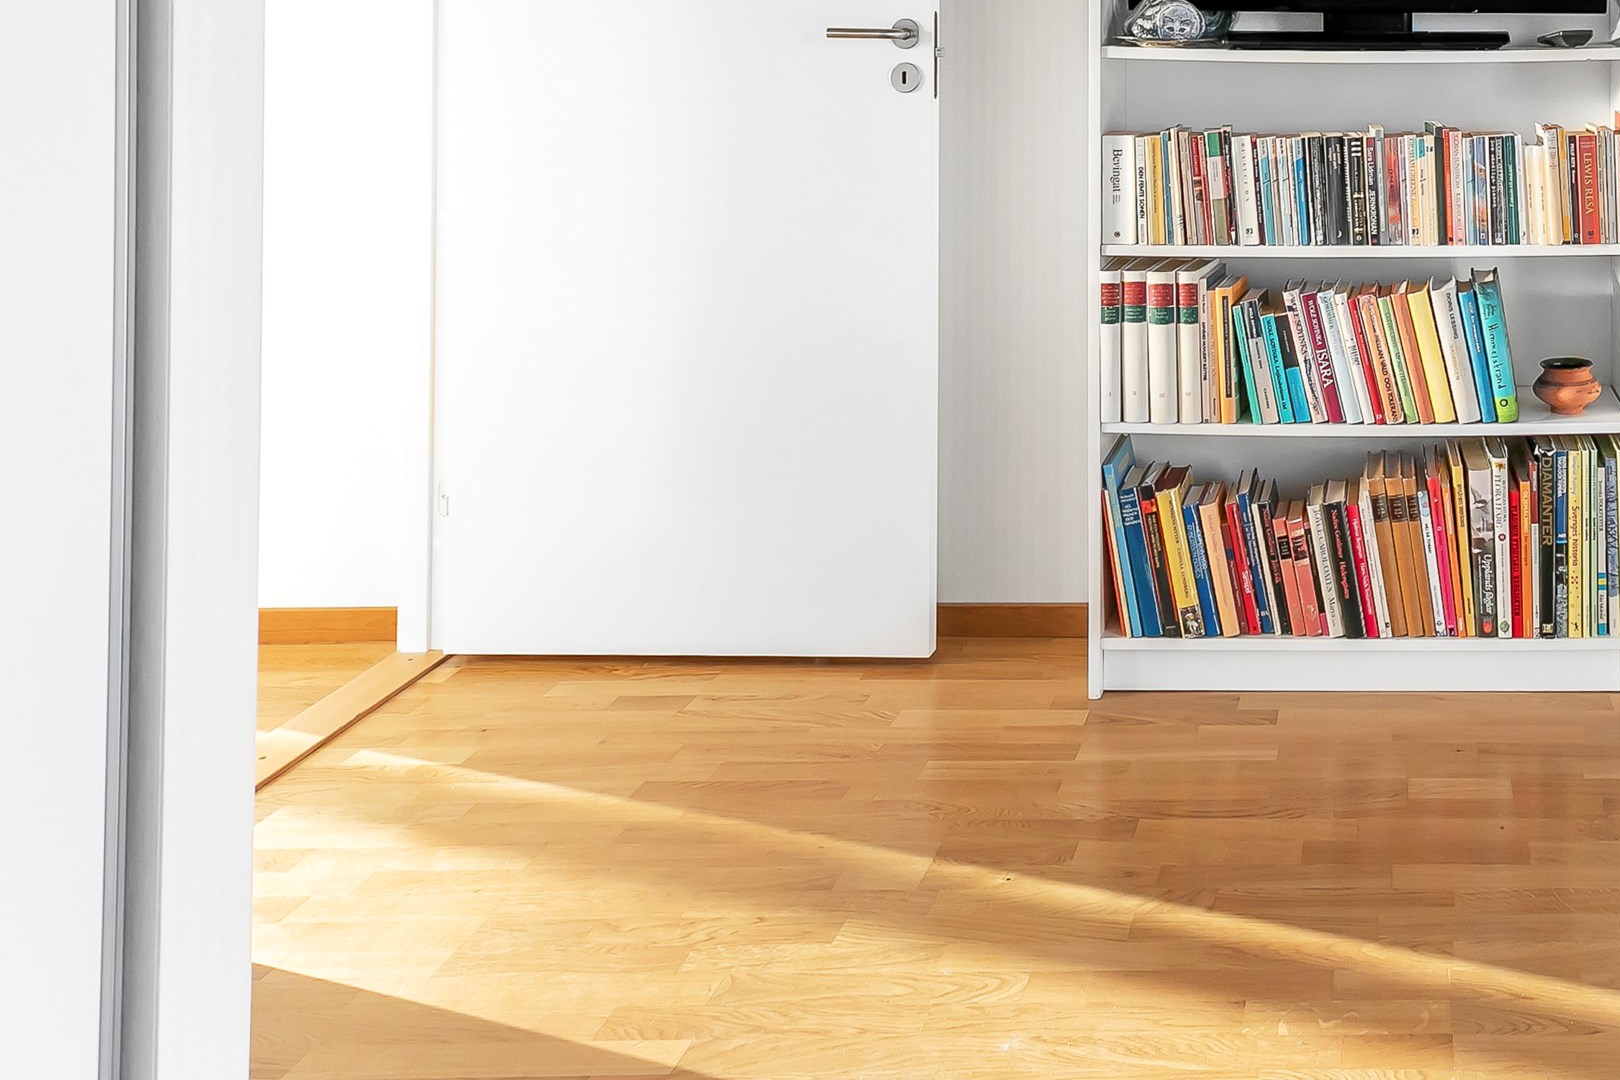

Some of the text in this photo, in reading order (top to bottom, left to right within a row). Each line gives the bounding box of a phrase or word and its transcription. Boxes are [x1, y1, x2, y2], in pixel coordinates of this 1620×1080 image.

[1111, 147, 1124, 192] Bevingat
[1409, 138, 1418, 197] GRAHAM GREENE
[1583, 152, 1594, 215] LEWIS RESA
[1369, 189, 1378, 235] JERNKRONAN
[1269, 337, 1278, 364] SOYINKA
[1293, 316, 1307, 355] SOYINKA
[1307, 299, 1334, 388] WOLE SOYINKA ISARA
[1449, 313, 1459, 341] LESSING
[1374, 333, 1399, 422] MELLAN VÅLD OCH TOLERANS
[1488, 323, 1508, 390] Himmelstrand
[1313, 509, 1323, 536] JOYCE
[1494, 475, 1504, 529] FLORA FÄRG
[1541, 457, 1553, 546] DIAMANTER
[1168, 499, 1190, 599] MUSIKENS MYTER CAMILLA LUNDBERG
[1262, 508, 1275, 556] Nadine Gordimer
[1316, 537, 1326, 563] CAROL
[1331, 509, 1344, 559] Nadine Gordimer
[1352, 518, 1363, 559] Hjalmar Bergman
[1571, 506, 1580, 567] Sveriges historia
[1241, 570, 1252, 594] Samspel
[1481, 554, 1495, 615] Upplands fåglar
[1327, 597, 1336, 618] Marya
